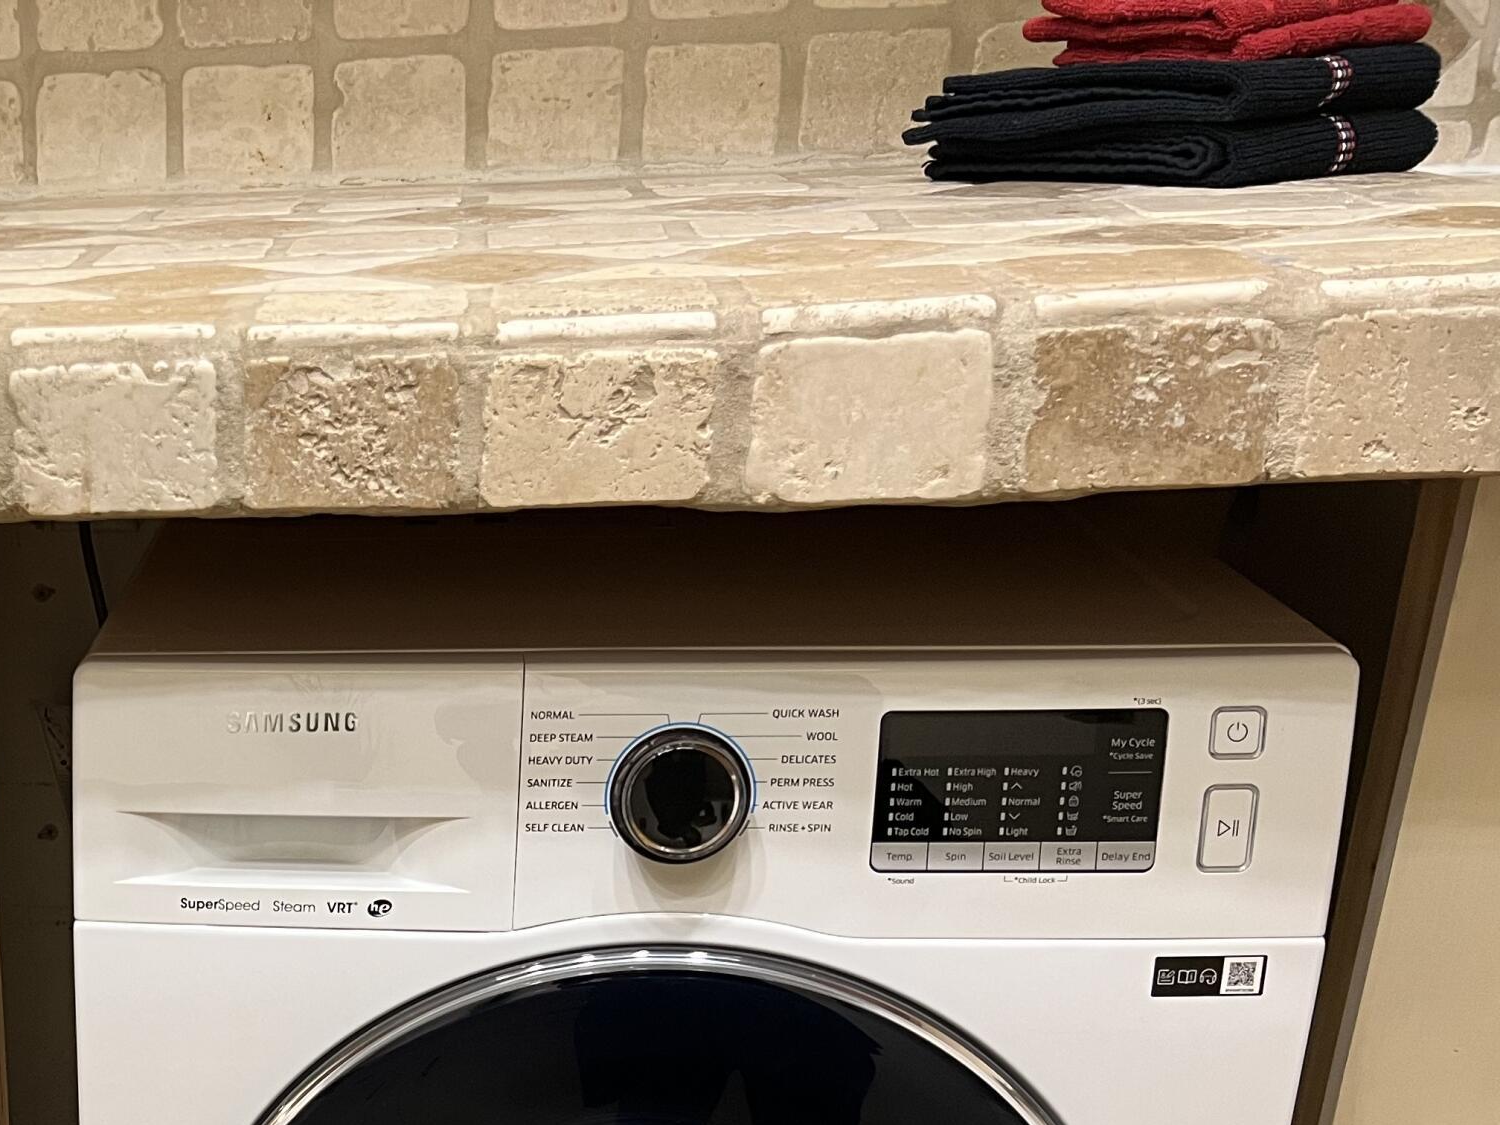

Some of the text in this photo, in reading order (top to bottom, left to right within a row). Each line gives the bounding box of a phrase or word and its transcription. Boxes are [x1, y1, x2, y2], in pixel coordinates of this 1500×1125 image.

[530, 711, 575, 720] NORMAL
[772, 709, 840, 719] QUICK WASH
[227, 711, 358, 732] SAMSUNG
[530, 733, 593, 743] DEEP STEAM
[806, 732, 838, 741] WOOL
[1111, 738, 1155, 748] My Cycle
[528, 756, 593, 765] HEAVY DUTY
[781, 755, 836, 764] DELICATES
[1135, 752, 1153, 760] Save
[898, 768, 939, 776] Extra Hot
[954, 768, 997, 778] Extra High
[1011, 768, 1039, 777] Heavy
[527, 778, 573, 788] SANITIZE
[770, 778, 835, 787] PERM PRESS
[897, 783, 913, 791] Hot
[953, 783, 973, 792] High
[1114, 791, 1143, 801] Super
[526, 801, 579, 810] ALLERGEN
[762, 801, 833, 810] ACTIVE WEAR
[896, 798, 922, 806] Warm
[951, 798, 987, 806] Medium
[1008, 797, 1040, 806] Normal
[1112, 801, 1143, 811] Speed
[895, 813, 914, 821] Cold
[951, 813, 968, 821] Low
[525, 823, 584, 832] SELF CLEAN
[769, 823, 798, 832] RINSE
[807, 823, 831, 832] SPIN
[1005, 827, 1028, 837] Light
[894, 828, 929, 837] Tap Cold
[949, 828, 982, 837] No Spin
[1057, 847, 1081, 856] Extra
[945, 852, 966, 862] Spin
[989, 852, 1034, 861] Soil Level
[1101, 852, 1151, 862] Delay End
[1056, 857, 1081, 866] Rinse
[180, 897, 260, 912] SuperSpeed
[273, 901, 316, 912] Steam
